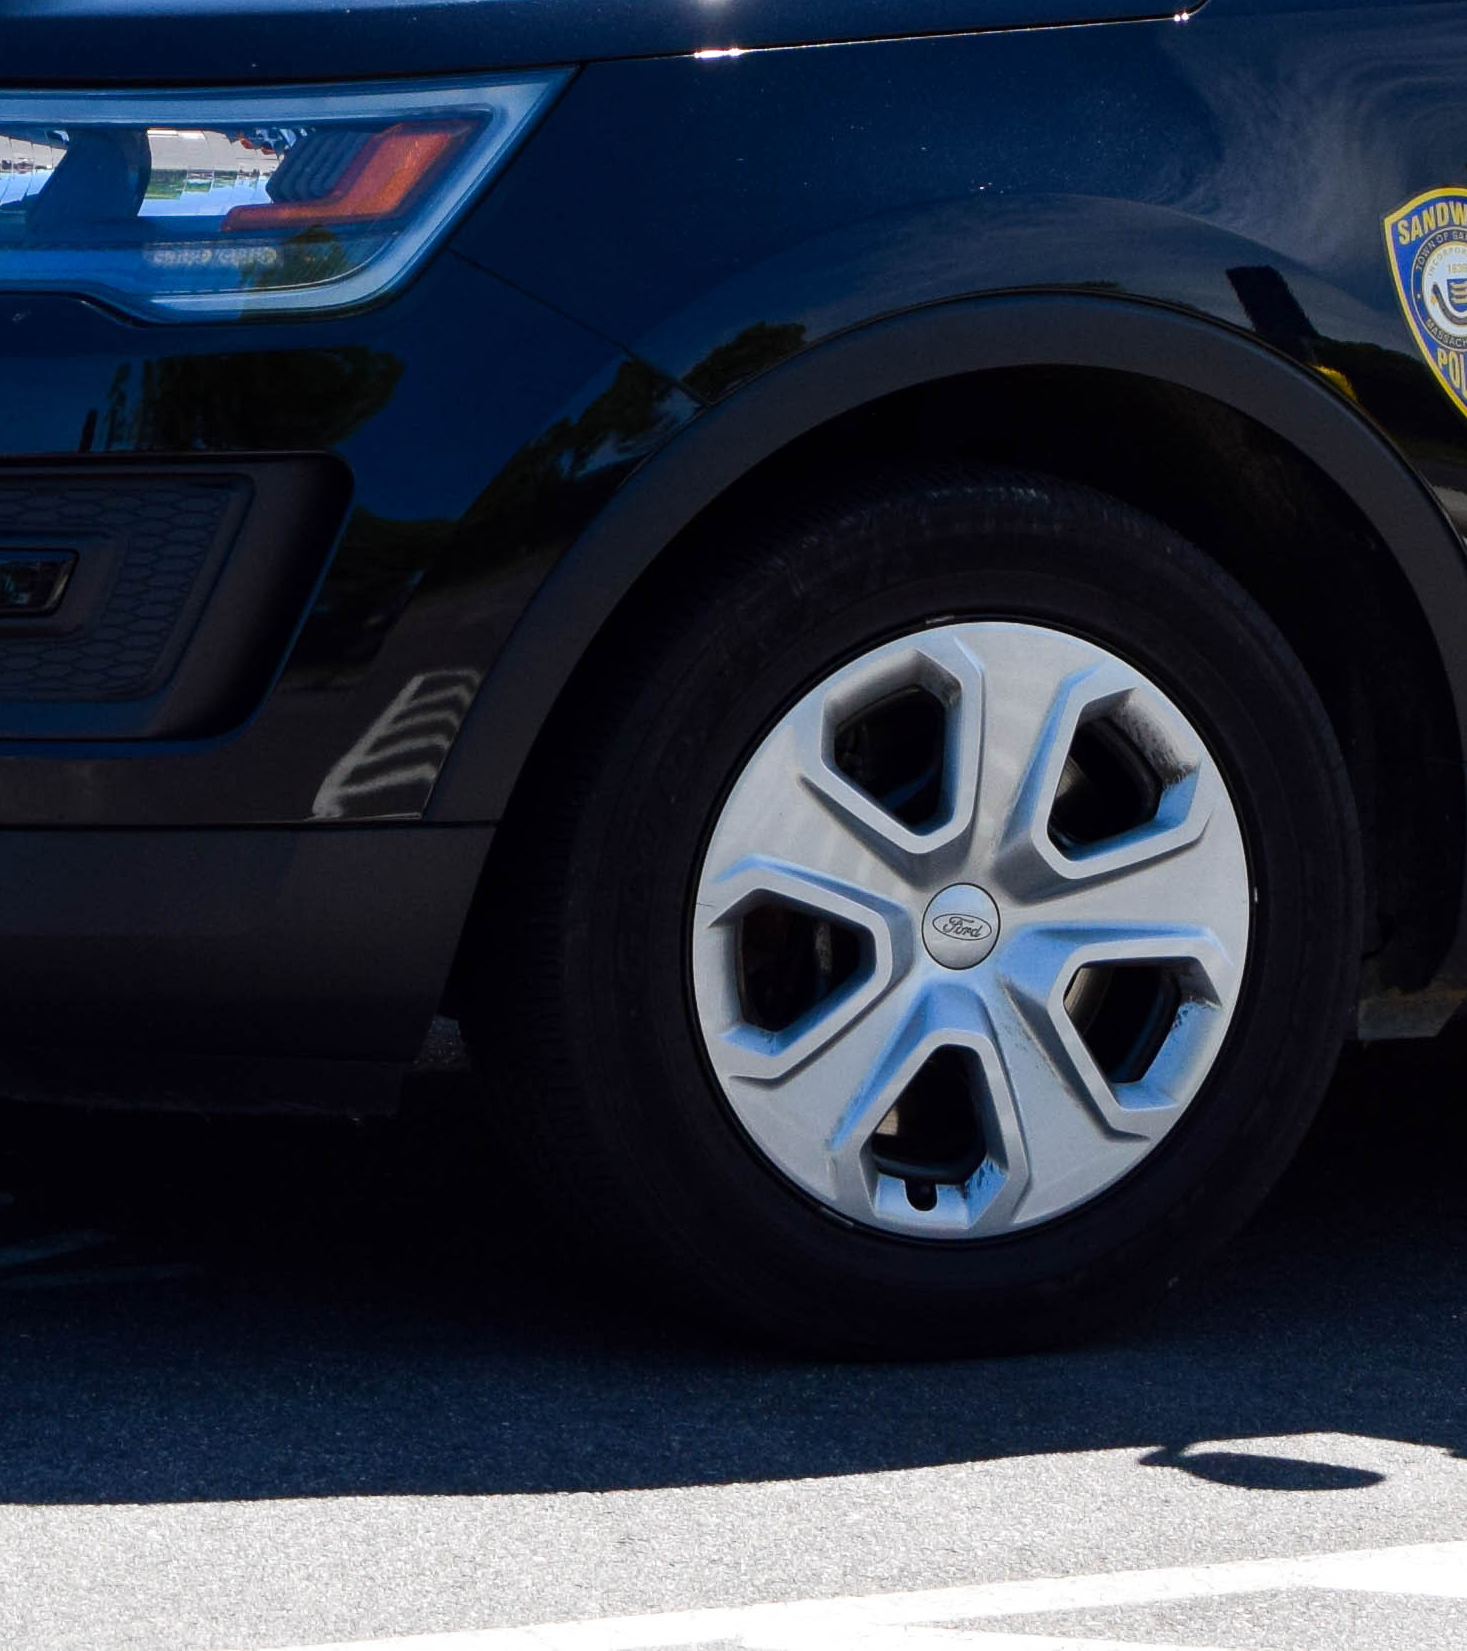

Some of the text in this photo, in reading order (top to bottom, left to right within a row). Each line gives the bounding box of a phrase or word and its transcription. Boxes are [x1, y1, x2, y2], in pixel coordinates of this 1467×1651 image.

[1416, 240, 1436, 270] TOWN
[1436, 232, 1449, 244] OF
[943, 916, 984, 937] Ford
